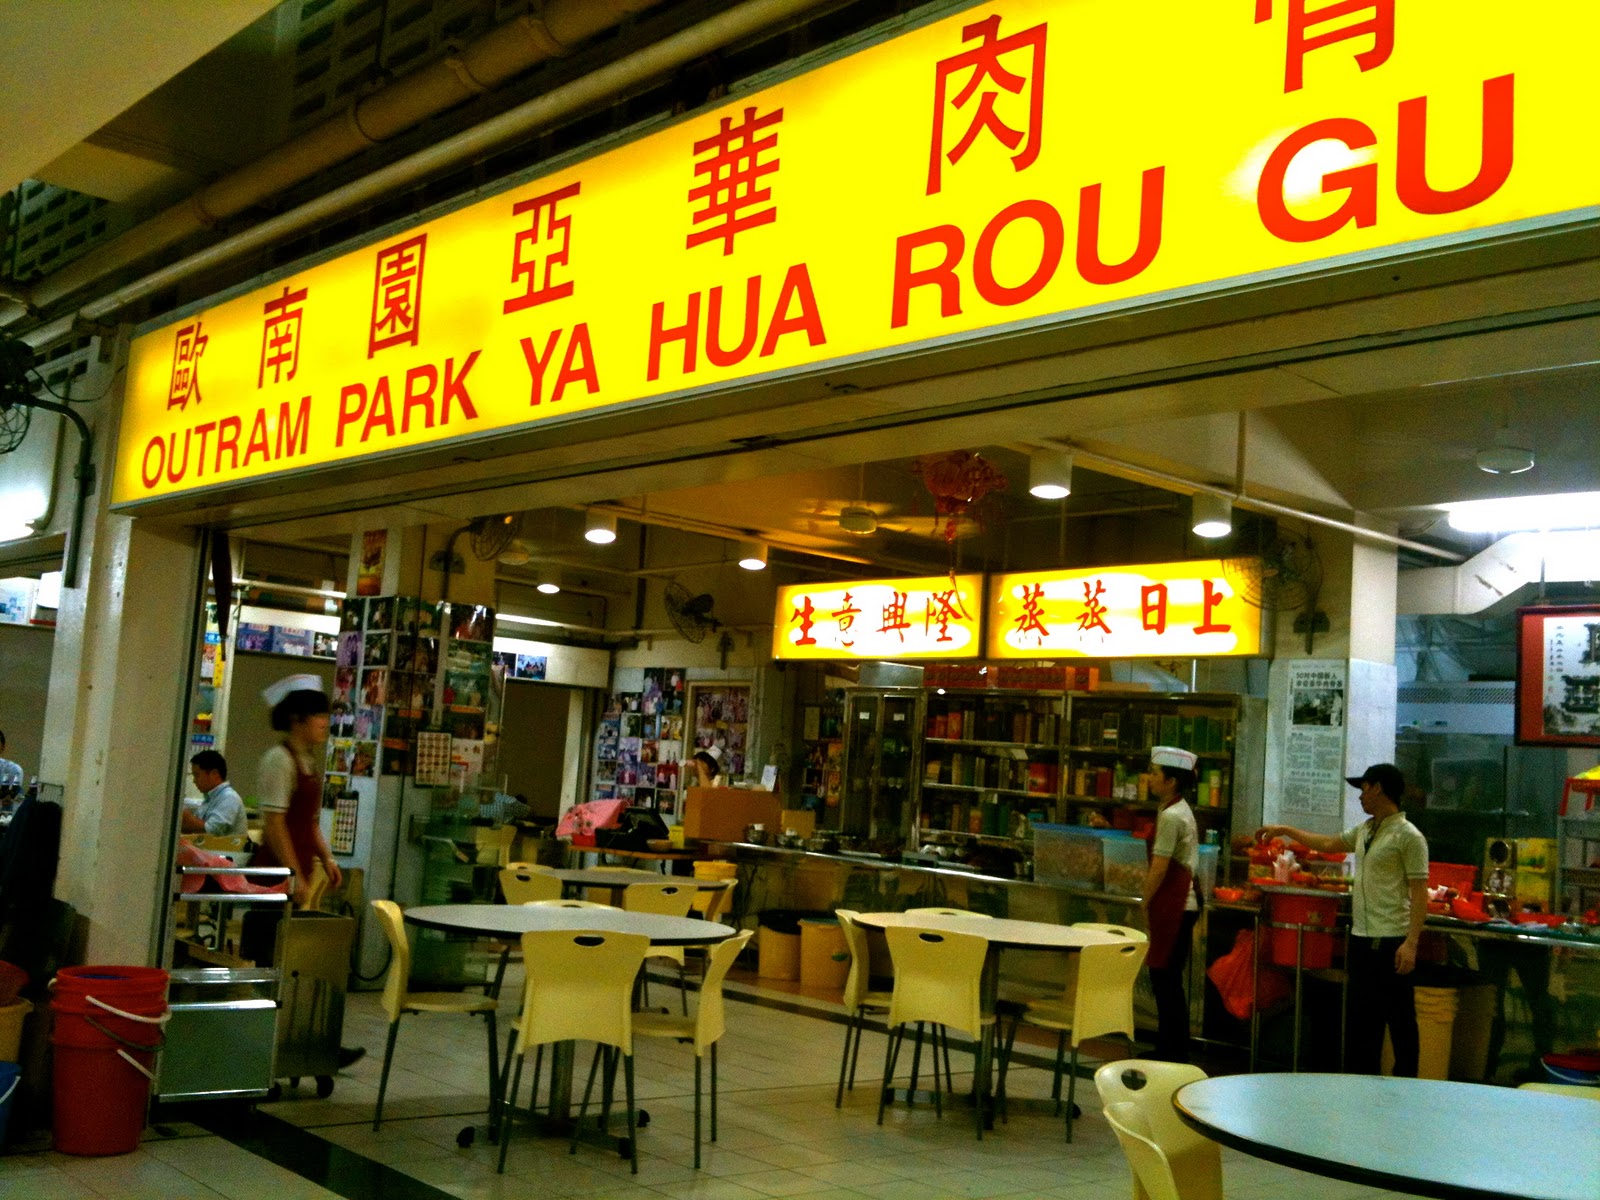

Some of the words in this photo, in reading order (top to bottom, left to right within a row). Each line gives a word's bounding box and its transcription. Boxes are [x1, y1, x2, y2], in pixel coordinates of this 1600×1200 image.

[142, 396, 311, 489] OUTRAM
[336, 350, 482, 447] PARK
[519, 322, 600, 406] YA
[647, 263, 827, 382] HUA
[890, 165, 1165, 329] ROU
[1257, 73, 1515, 243] GU
[790, 589, 963, 647] 生意興隆
[1014, 579, 1232, 645] 蒸蒸日上
